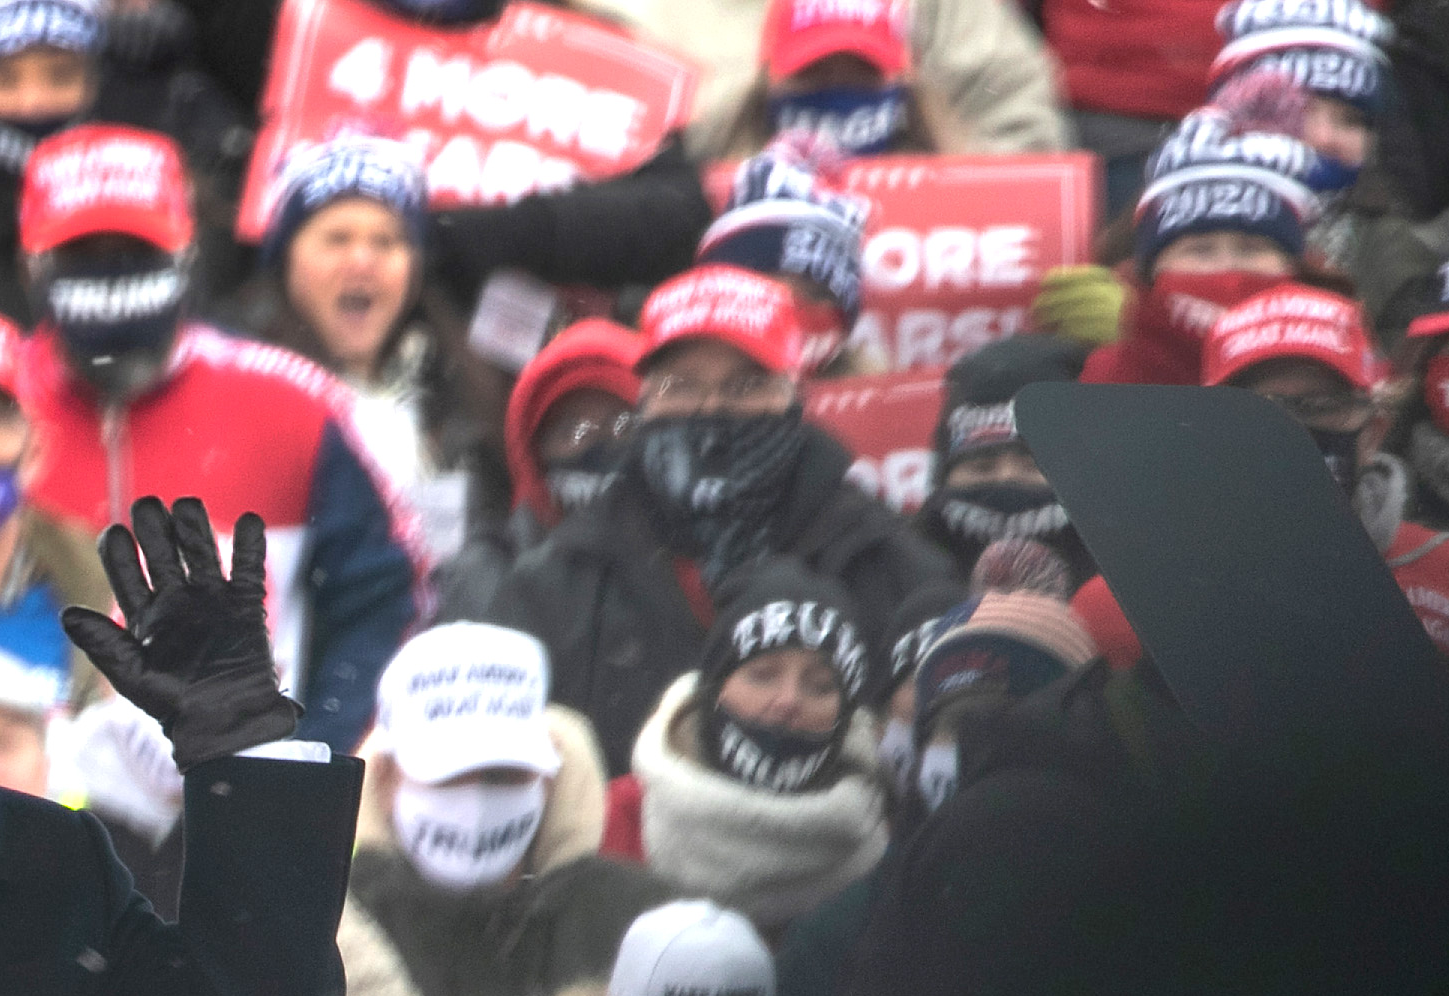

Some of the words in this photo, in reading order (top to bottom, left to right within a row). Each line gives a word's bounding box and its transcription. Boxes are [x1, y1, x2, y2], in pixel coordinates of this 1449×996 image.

[329, 37, 392, 103] 4
[402, 46, 645, 161] MORE
[863, 226, 1037, 293] ORE
